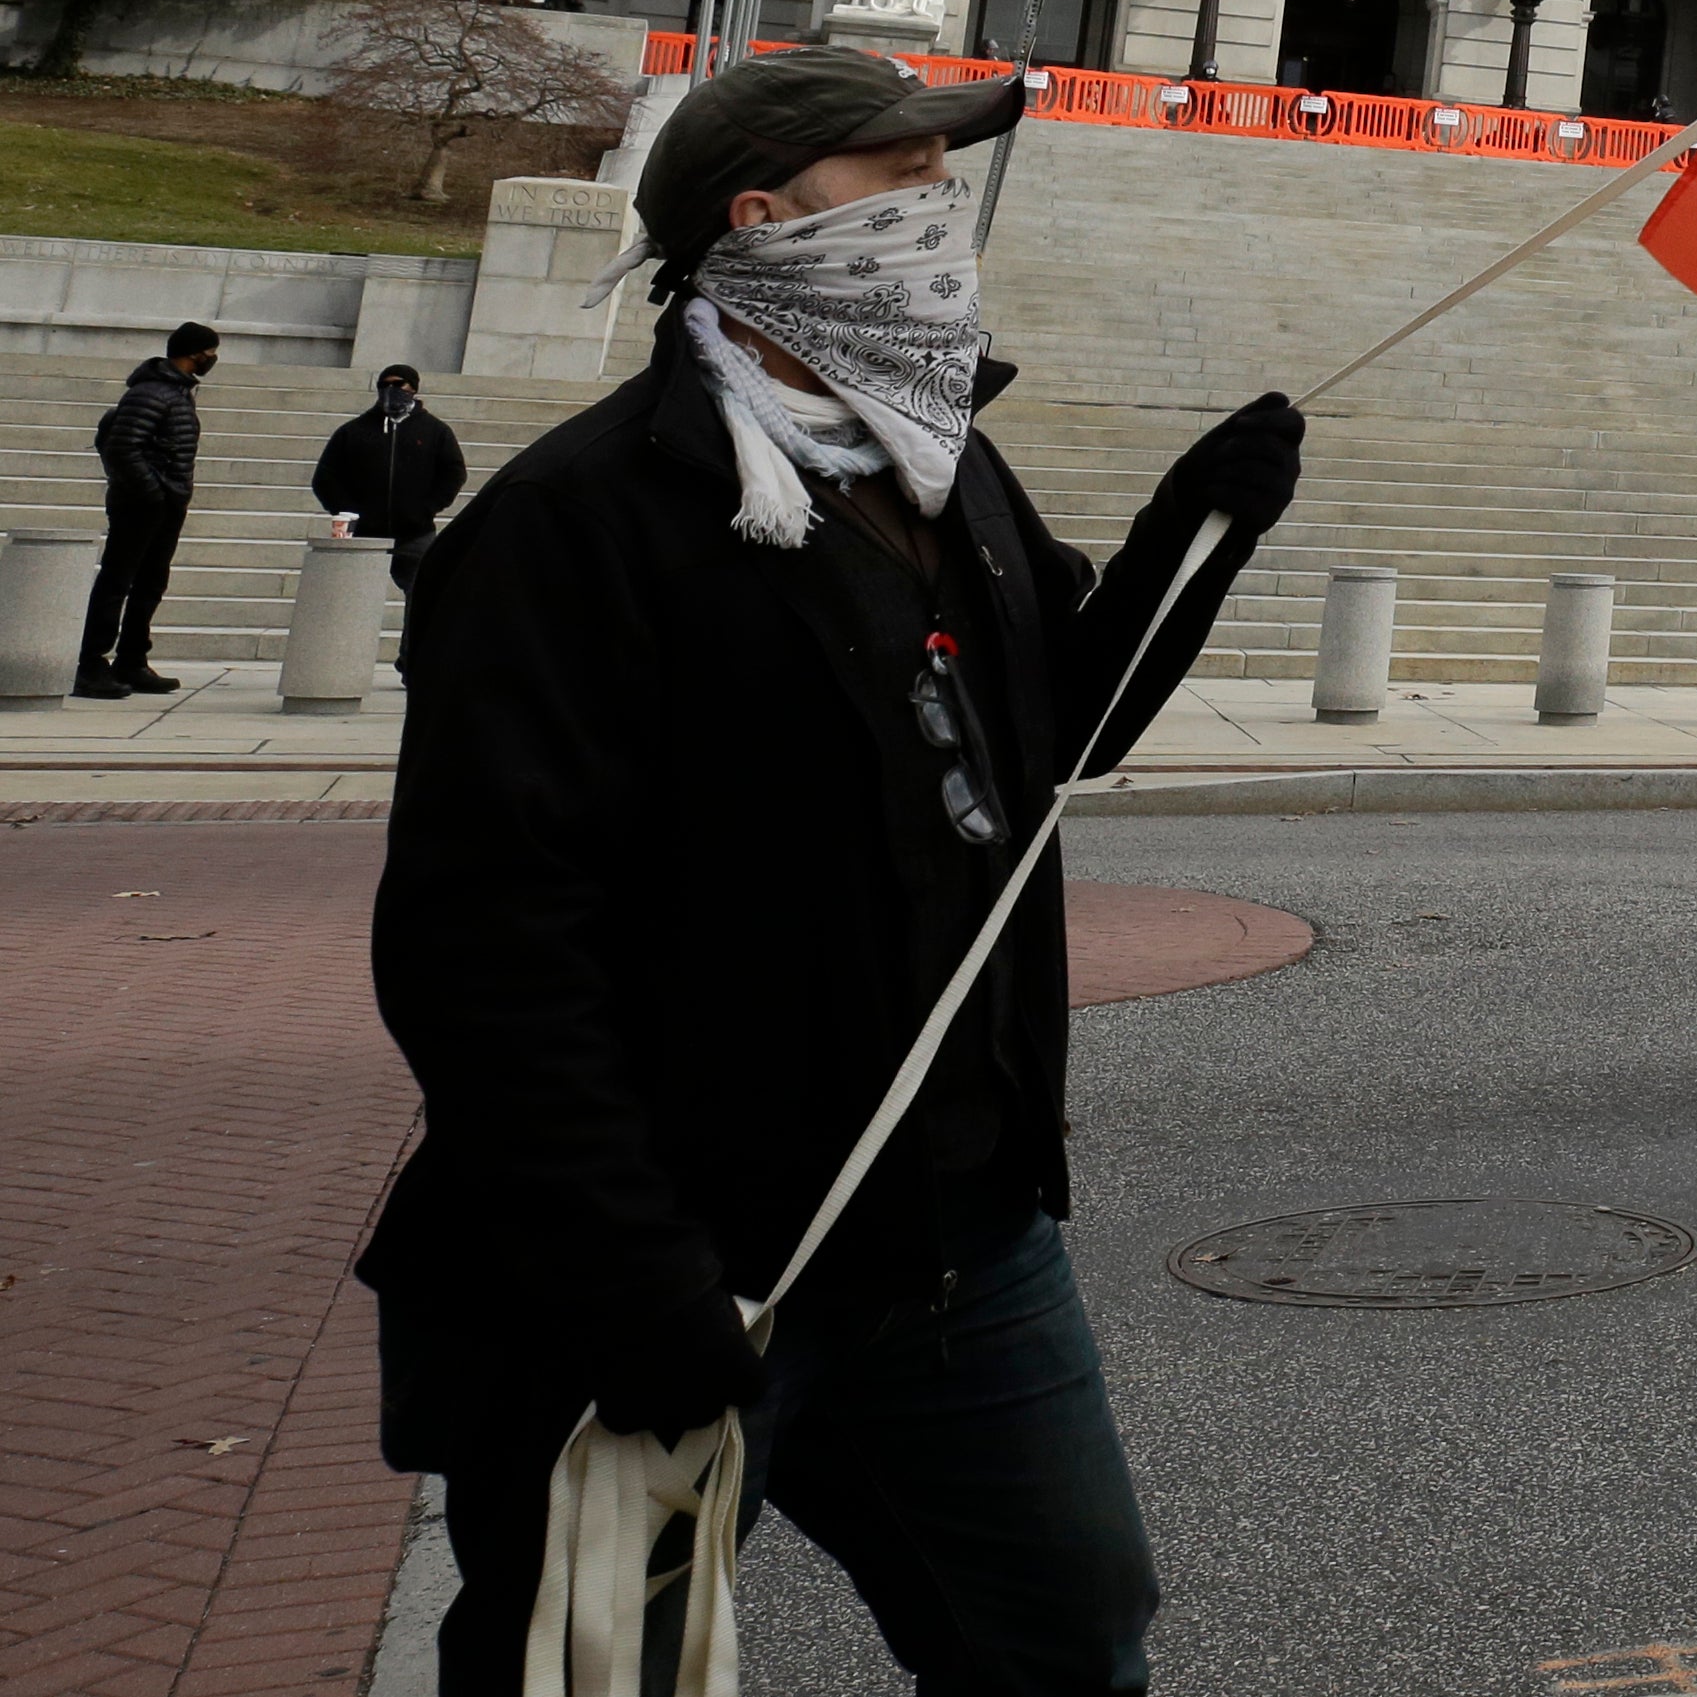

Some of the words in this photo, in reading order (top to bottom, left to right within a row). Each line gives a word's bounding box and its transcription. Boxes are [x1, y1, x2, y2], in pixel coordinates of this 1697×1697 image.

[509, 185, 537, 201] IN
[552, 188, 613, 207] GOD
[497, 203, 533, 222] WE
[549, 207, 619, 228] TRUST
[80, 244, 152, 263] THERE
[162, 249, 179, 264] IS
[234, 254, 340, 273] COUNTRY
